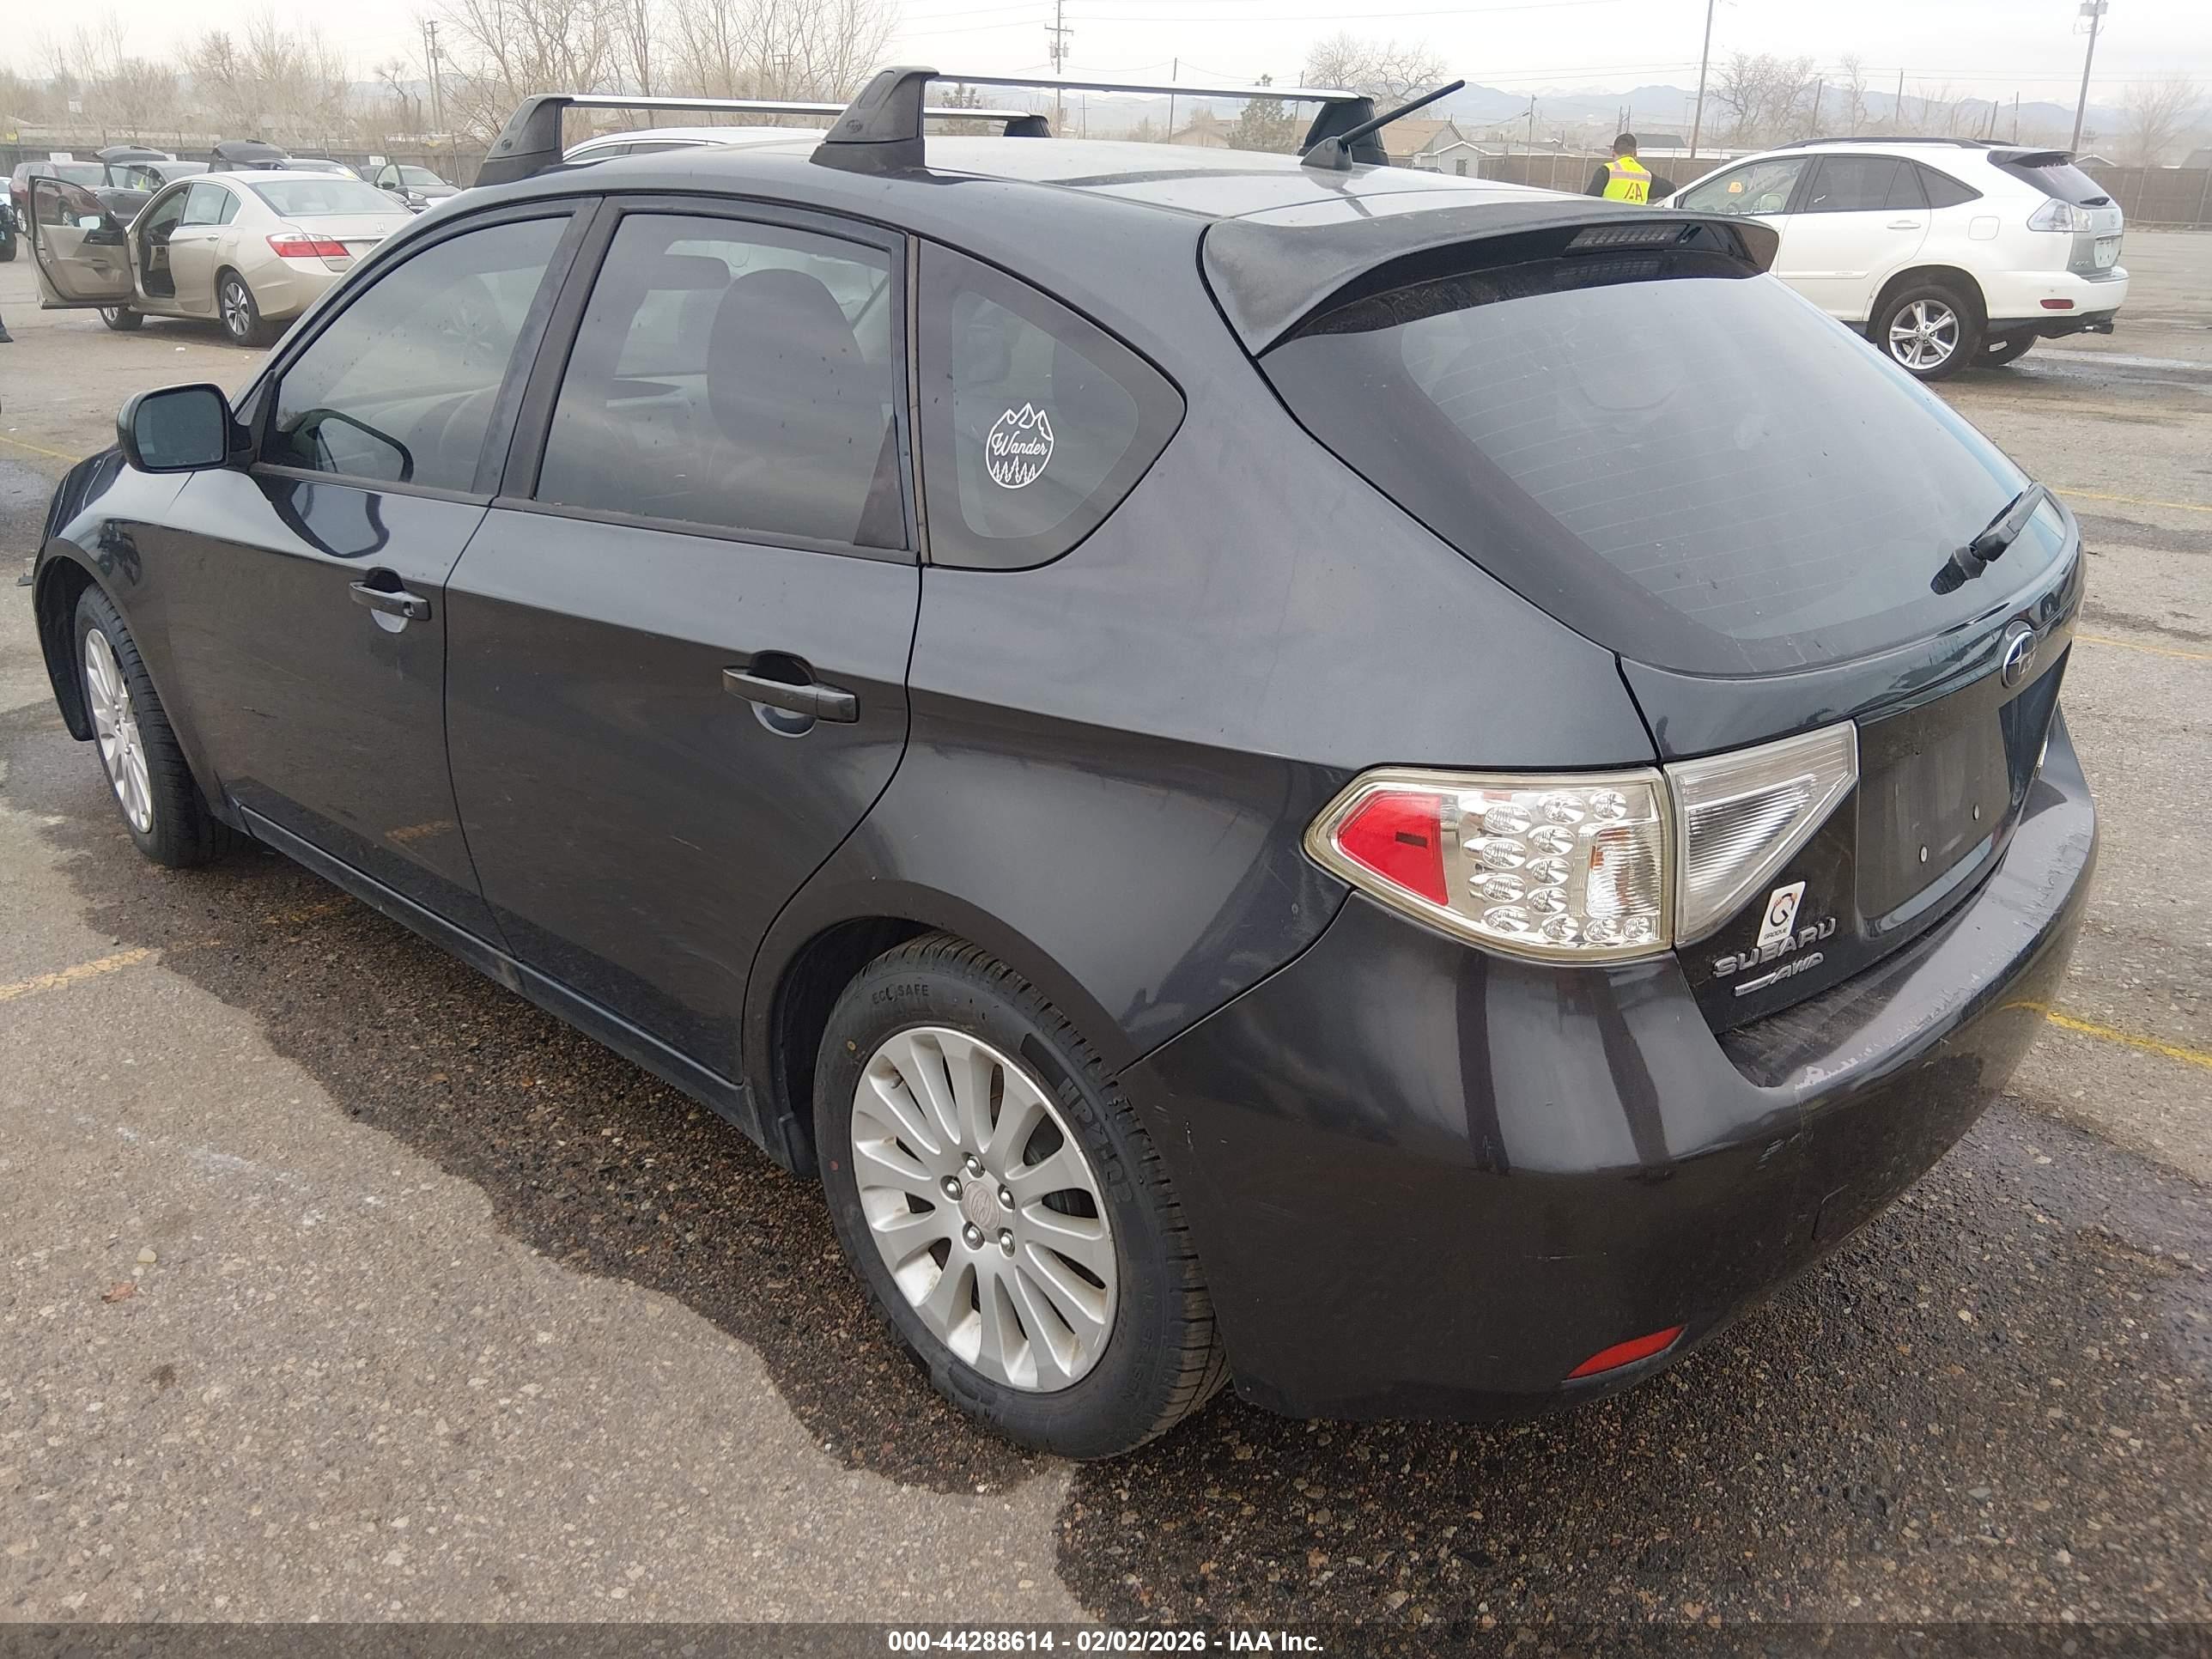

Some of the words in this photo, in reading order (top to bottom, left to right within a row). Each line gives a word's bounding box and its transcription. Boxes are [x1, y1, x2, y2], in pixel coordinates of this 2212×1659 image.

[991, 430, 1048, 457] Wander
[1712, 917, 1838, 979] SUBARU
[1764, 928, 1788, 939] GROOVE
[1771, 951, 1825, 985] AWD
